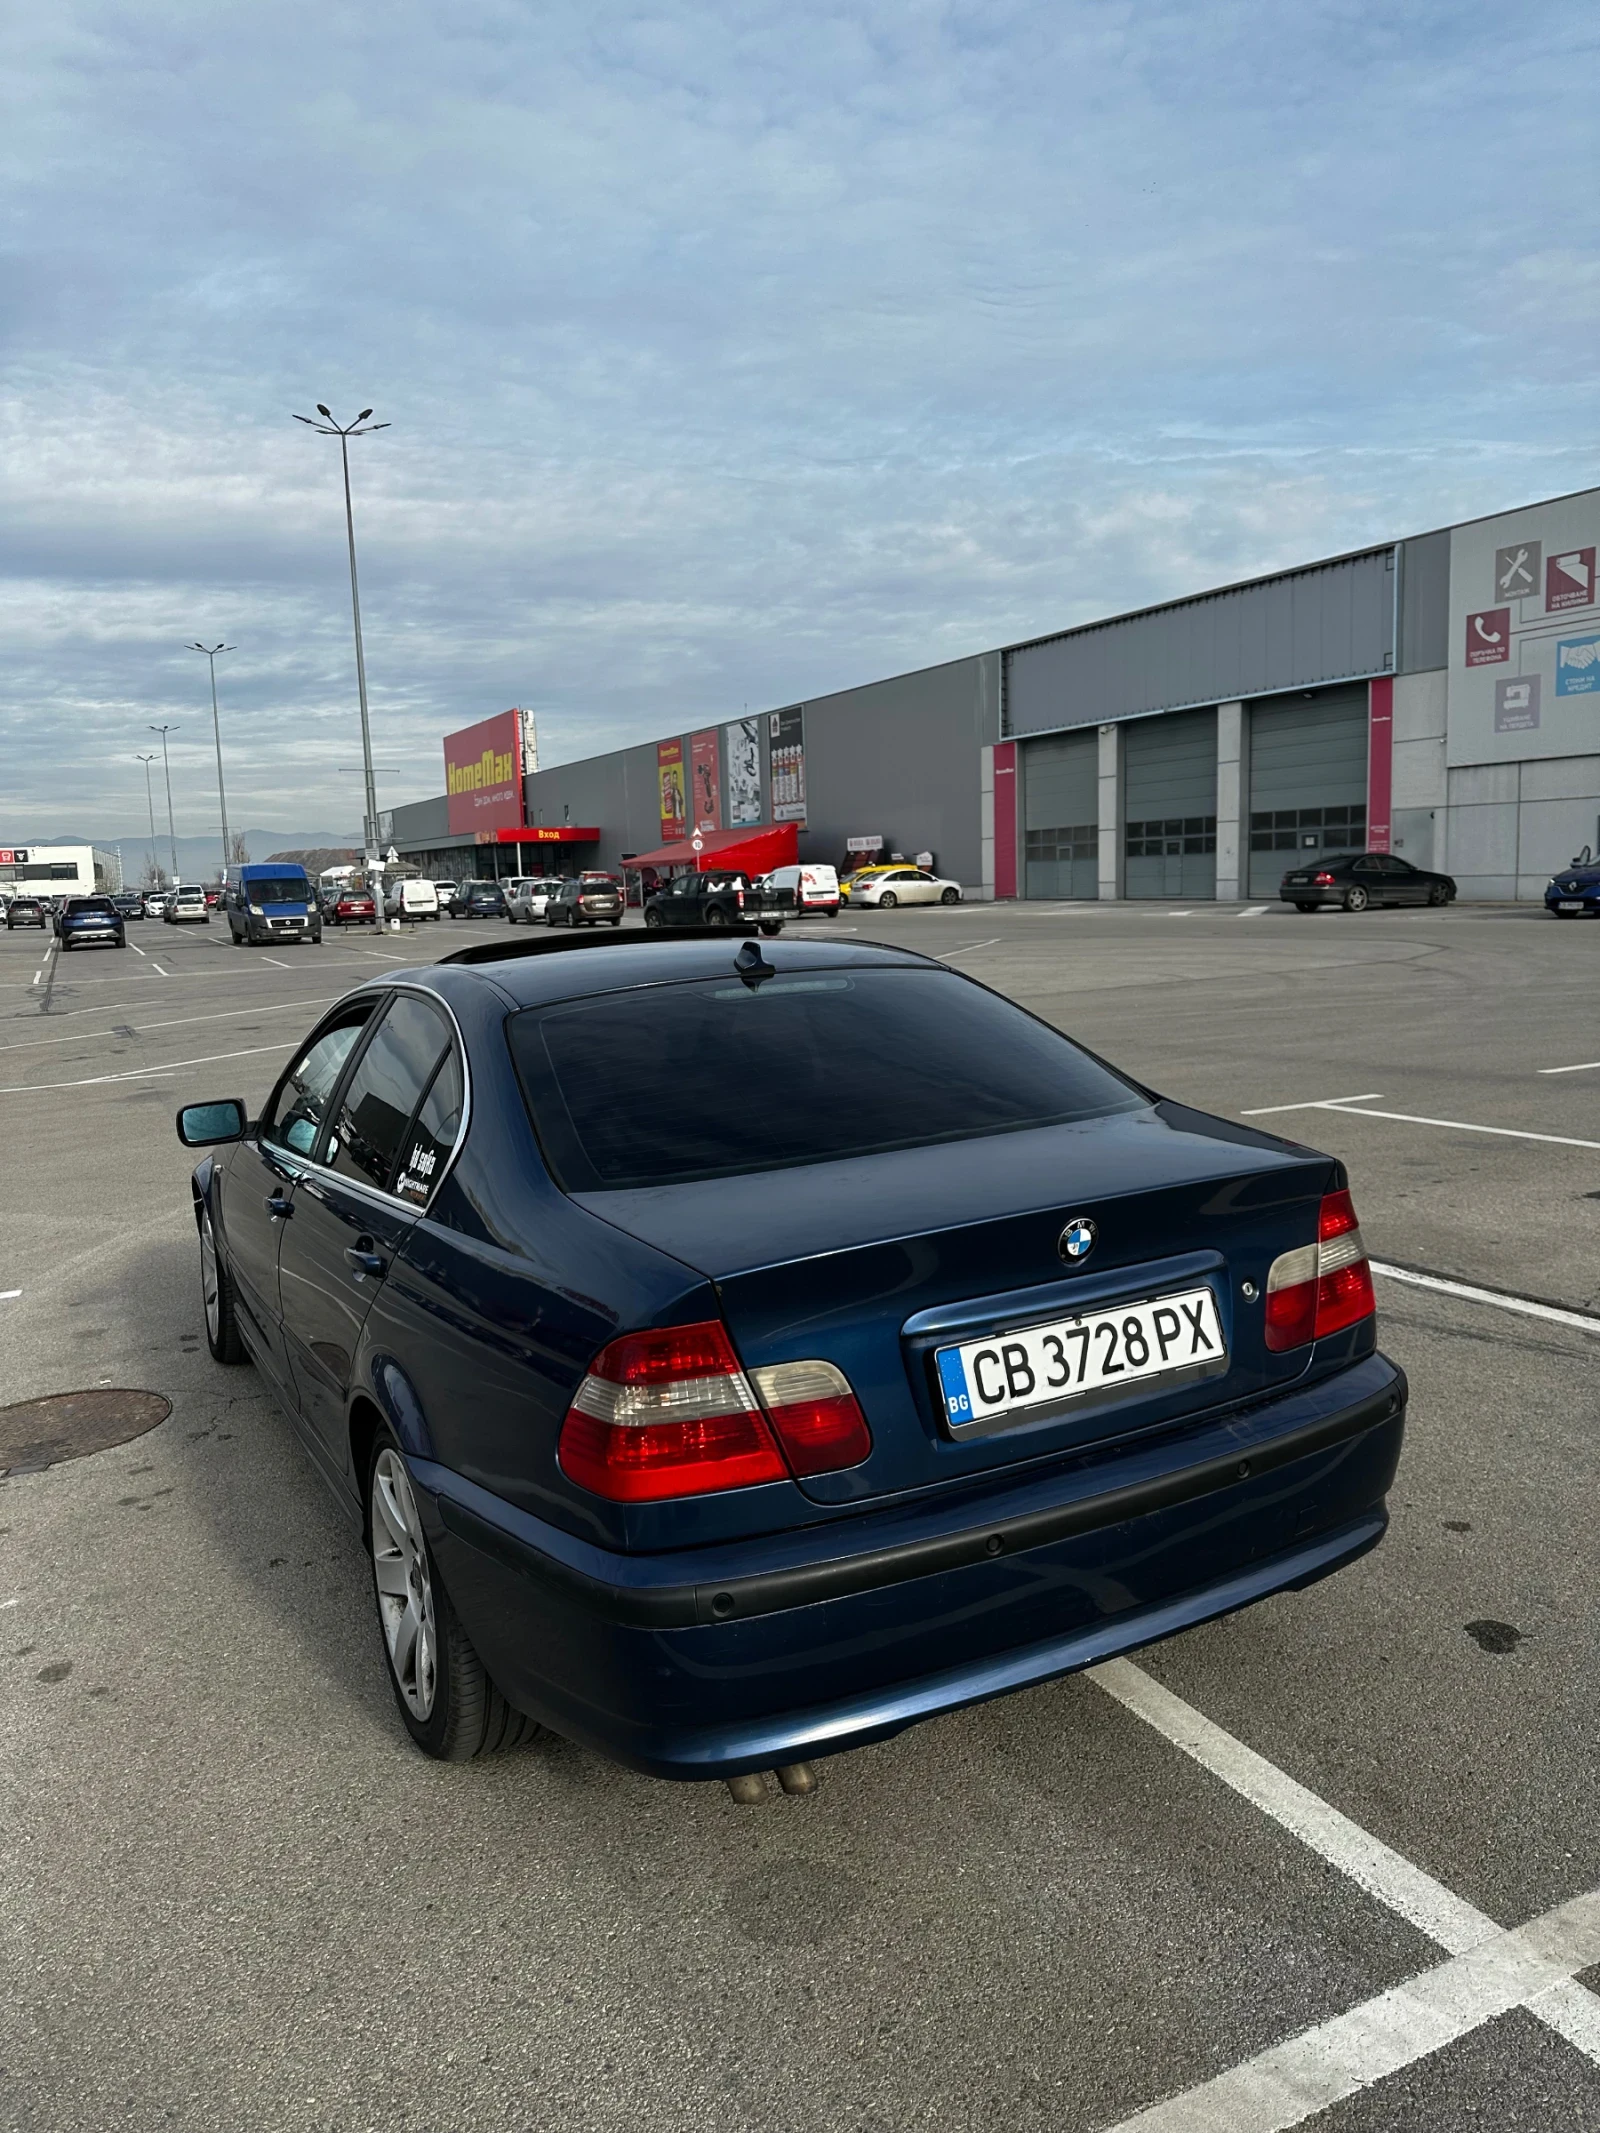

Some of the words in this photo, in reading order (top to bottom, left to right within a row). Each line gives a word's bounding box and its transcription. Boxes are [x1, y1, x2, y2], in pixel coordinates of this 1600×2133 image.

[1551, 590, 1588, 602] ОБТОЧВАНЕ
[1551, 601, 1561, 609] НА
[1469, 648, 1496, 658] ПОРЪЧКА
[1472, 654, 1502, 664] ТЕЛЕФОНА
[1565, 676, 1585, 686] СТОКИ
[1567, 683, 1592, 692] КРЕДИТ
[448, 749, 513, 796] HomeMax
[538, 830, 560, 839] Вход
[1065, 1221, 1096, 1238] BMW
[973, 1343, 1036, 1405] CB
[1042, 1316, 1149, 1388] 3728
[1152, 1300, 1214, 1361] PX
[949, 1393, 969, 1415] BG
